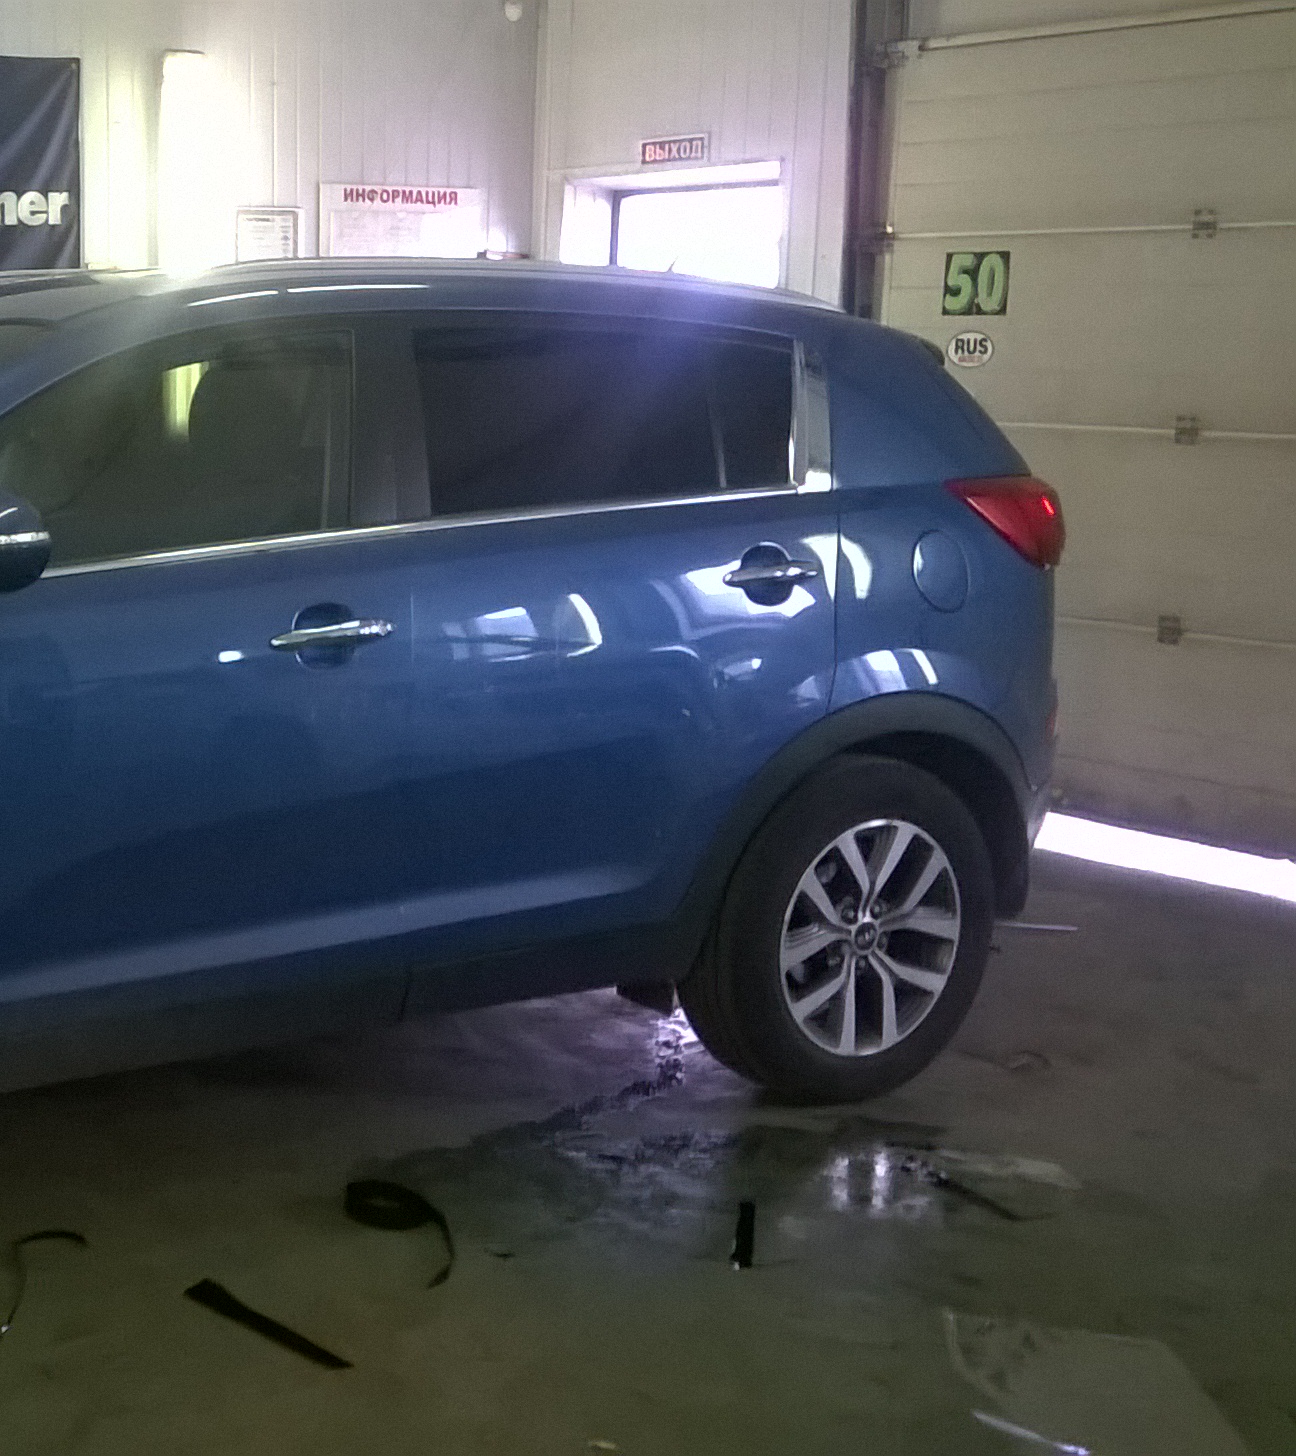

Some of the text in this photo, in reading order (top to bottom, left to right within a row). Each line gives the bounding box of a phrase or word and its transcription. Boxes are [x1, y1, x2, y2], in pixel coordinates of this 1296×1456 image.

[645, 140, 702, 162] ВЫХОД
[343, 187, 459, 207] ИНФОРМАЦИЯ
[944, 253, 1005, 312] 50
[954, 337, 989, 355] RUS
